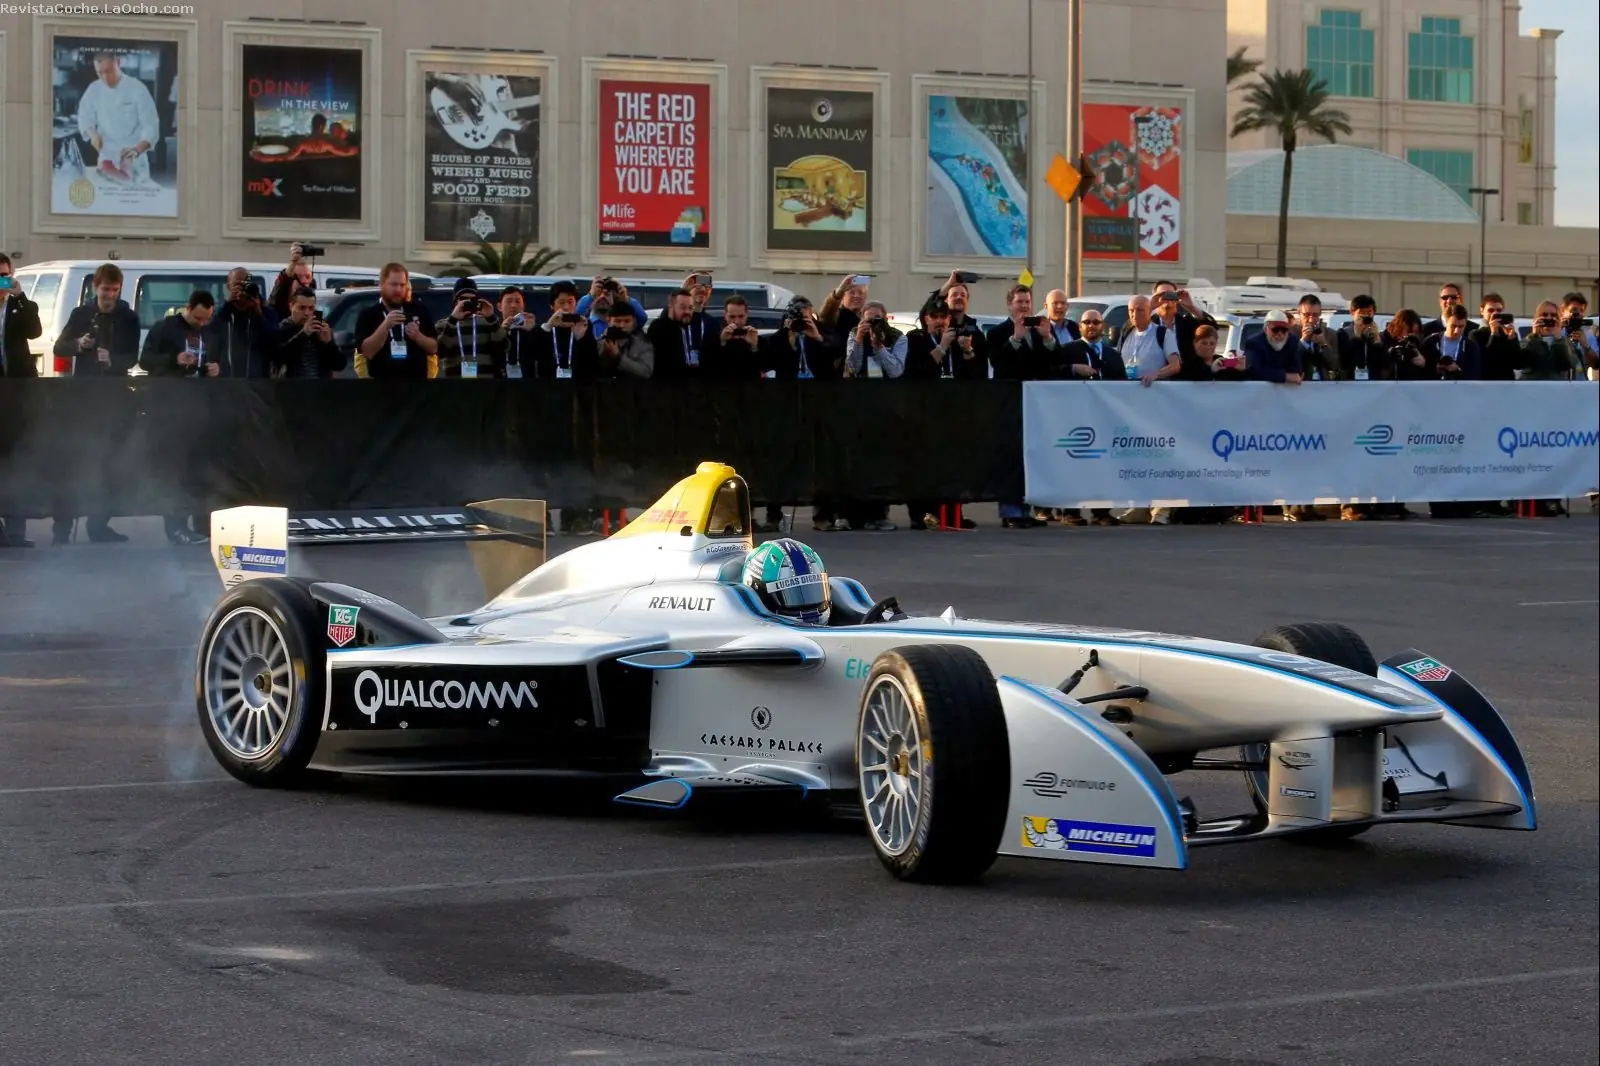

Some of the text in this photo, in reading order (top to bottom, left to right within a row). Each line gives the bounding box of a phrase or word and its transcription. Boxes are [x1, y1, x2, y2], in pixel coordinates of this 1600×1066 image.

[248, 78, 311, 97] DRINK
[281, 99, 349, 111] IN THE VIEW
[614, 92, 695, 122] THE RED
[614, 121, 695, 146] CARPET IS
[796, 124, 868, 143] MANDALAY
[432, 154, 532, 165] HOUSE OF BLUES
[614, 145, 695, 168] WHEREVER
[432, 166, 532, 179] WHERE MUSIC
[614, 167, 695, 195] YOU ARE
[432, 182, 531, 197] FOOD FEED
[603, 204, 635, 218] Mlife
[1211, 429, 1326, 462] QUALCOMM
[1118, 468, 1272, 480] Official Founding and Technology Partner
[1439, 464, 1471, 475] Founding
[1472, 464, 1486, 474] and
[1488, 464, 1526, 475] Technology
[1527, 463, 1553, 473] Partner
[288, 513, 466, 530] ENAULT
[242, 553, 286, 565] MICHELIN
[775, 577, 800, 590] LUCAS
[648, 596, 715, 612] RENAULT
[333, 608, 352, 624] TAG
[330, 626, 354, 644] HEUER
[846, 658, 871, 680] Ele
[1405, 661, 1435, 673] TAG
[1416, 667, 1449, 680] HEUER
[700, 733, 823, 754] CAESARS PALACE
[1068, 828, 1156, 846] MICHELIN
